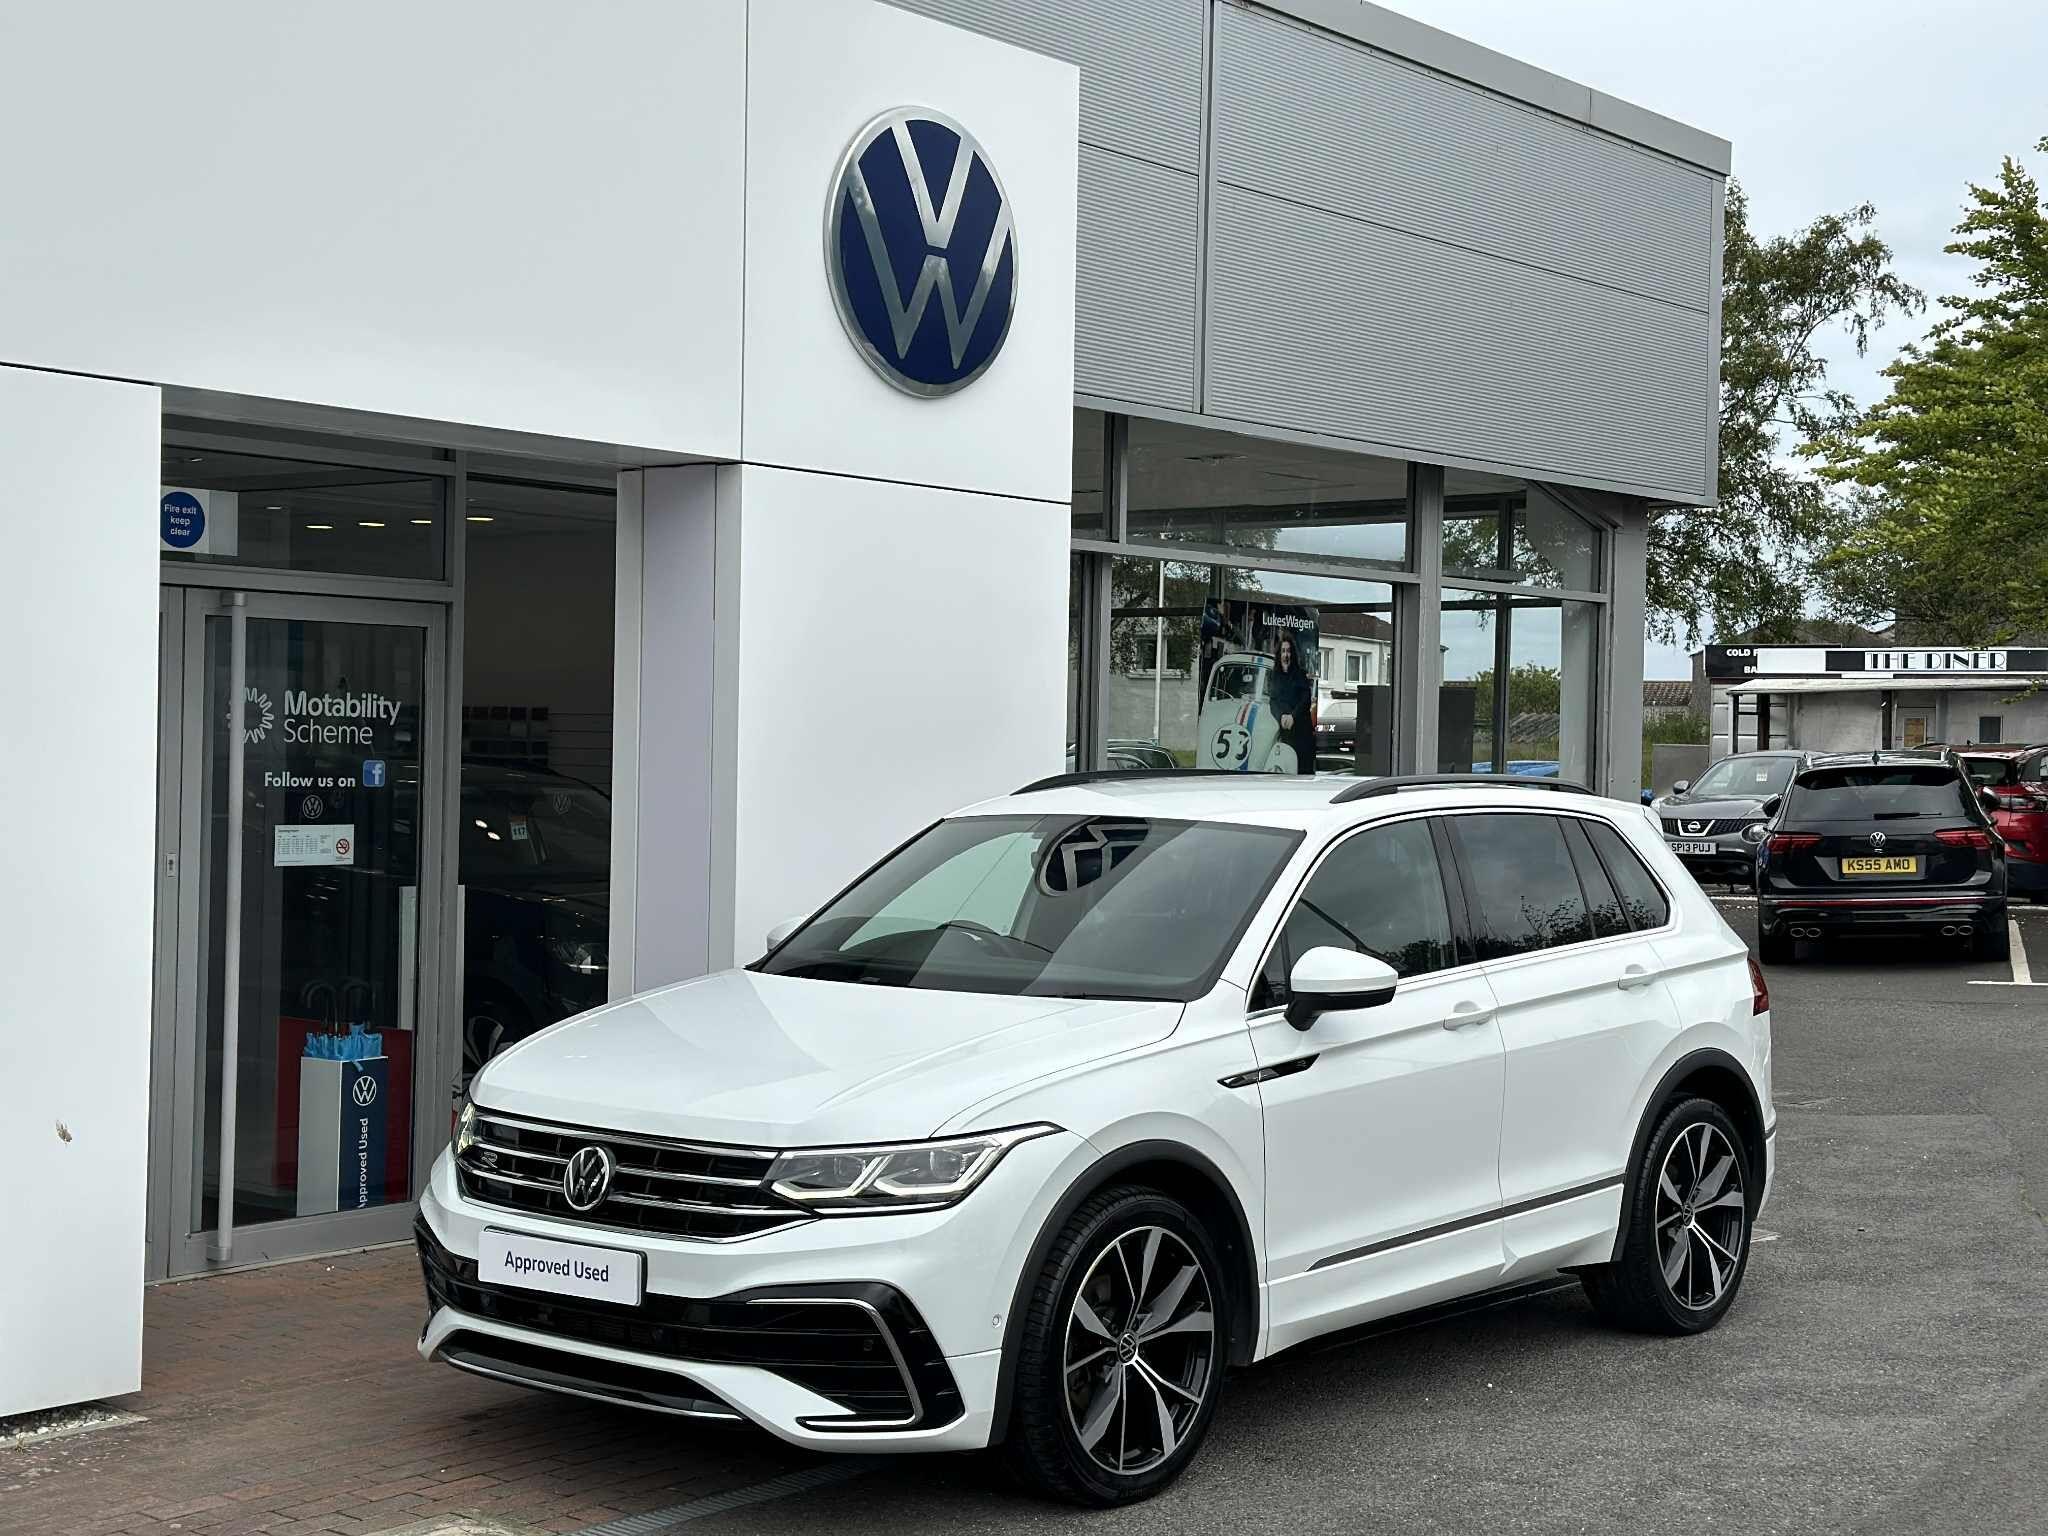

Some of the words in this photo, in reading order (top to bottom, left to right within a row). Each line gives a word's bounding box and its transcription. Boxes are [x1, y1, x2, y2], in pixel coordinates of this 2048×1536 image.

[164, 504, 180, 513] Fire
[182, 506, 197, 514] exit
[170, 516, 191, 526] keep
[170, 528, 191, 536] clear
[1262, 613, 1314, 631] LukesWagen
[1726, 648, 1751, 656] COLD
[1866, 653, 1917, 669] THE
[1924, 653, 2006, 669] DINER
[284, 690, 401, 726] Motability
[283, 719, 373, 744] Scheme
[1216, 729, 1249, 760] 53
[264, 771, 312, 787] Follow
[317, 777, 334, 787] us
[338, 777, 356, 787] on
[1671, 843, 1691, 852] SP13
[1693, 843, 1711, 852] PUJ
[1847, 859, 1881, 871] KS55
[1885, 859, 1910, 870] AMO
[358, 1118, 368, 1150] Used
[505, 1251, 570, 1276] Approved
[574, 1261, 609, 1282] Used
